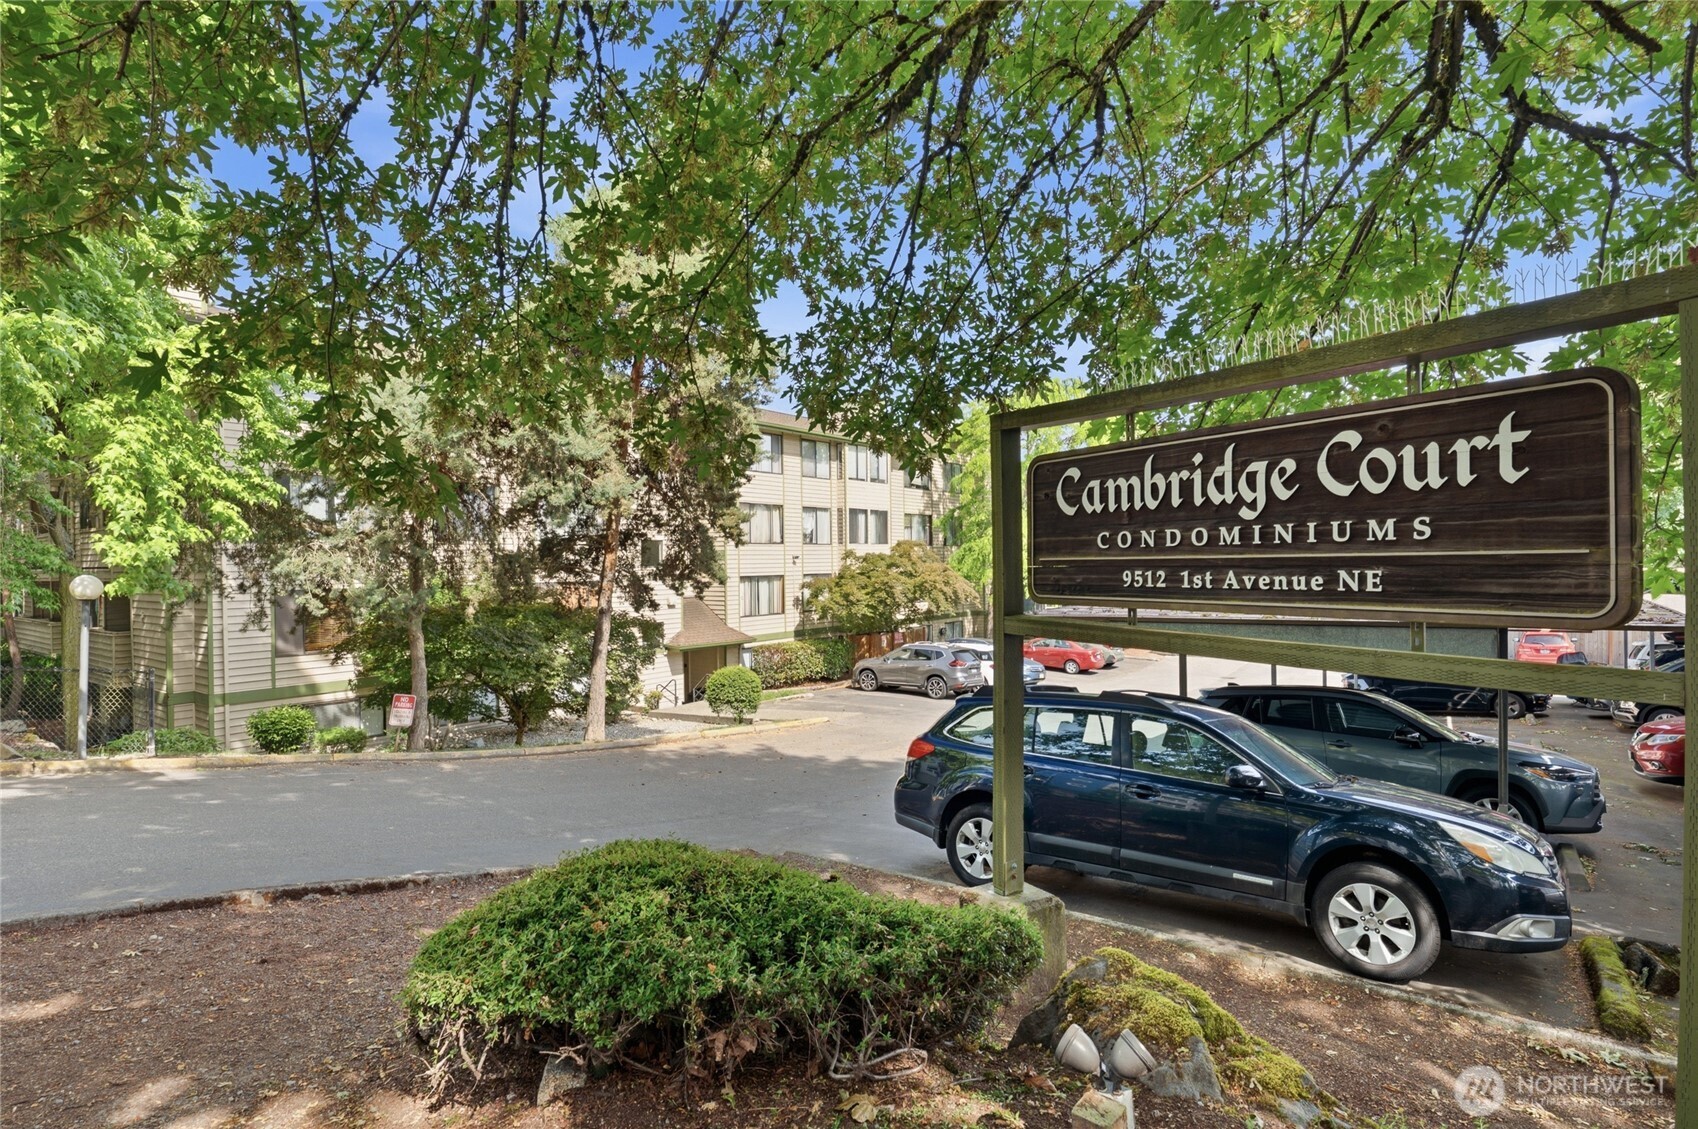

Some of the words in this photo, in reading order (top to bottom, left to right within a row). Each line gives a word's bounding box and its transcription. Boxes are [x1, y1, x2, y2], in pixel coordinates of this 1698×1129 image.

[1056, 443, 1300, 521] Cambridge
[1316, 410, 1532, 497] Court
[1097, 516, 1432, 549] CONDOMINIUMS
[1122, 570, 1167, 588] 9512
[1180, 570, 1213, 589] 1st
[1222, 569, 1324, 591] Avenue
[1337, 569, 1383, 592] NE
